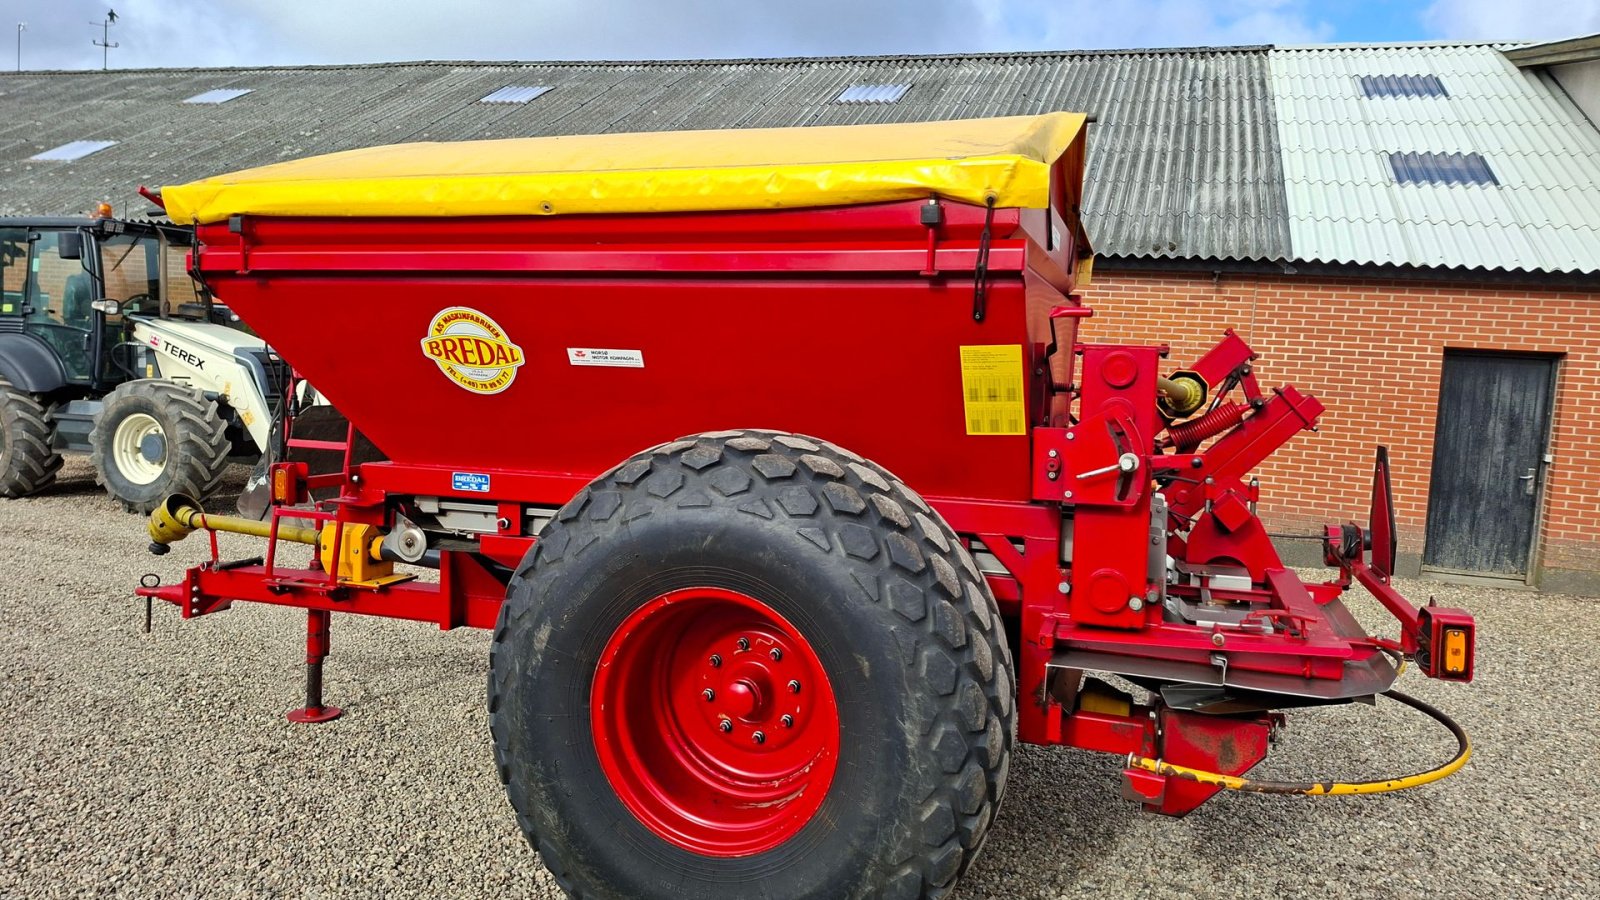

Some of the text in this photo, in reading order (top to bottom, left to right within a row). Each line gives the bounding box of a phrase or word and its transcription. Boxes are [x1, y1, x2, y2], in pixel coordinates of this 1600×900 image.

[163, 340, 206, 370] TEREX
[428, 337, 519, 366] BREDAL
[454, 475, 488, 483] BREDAL
